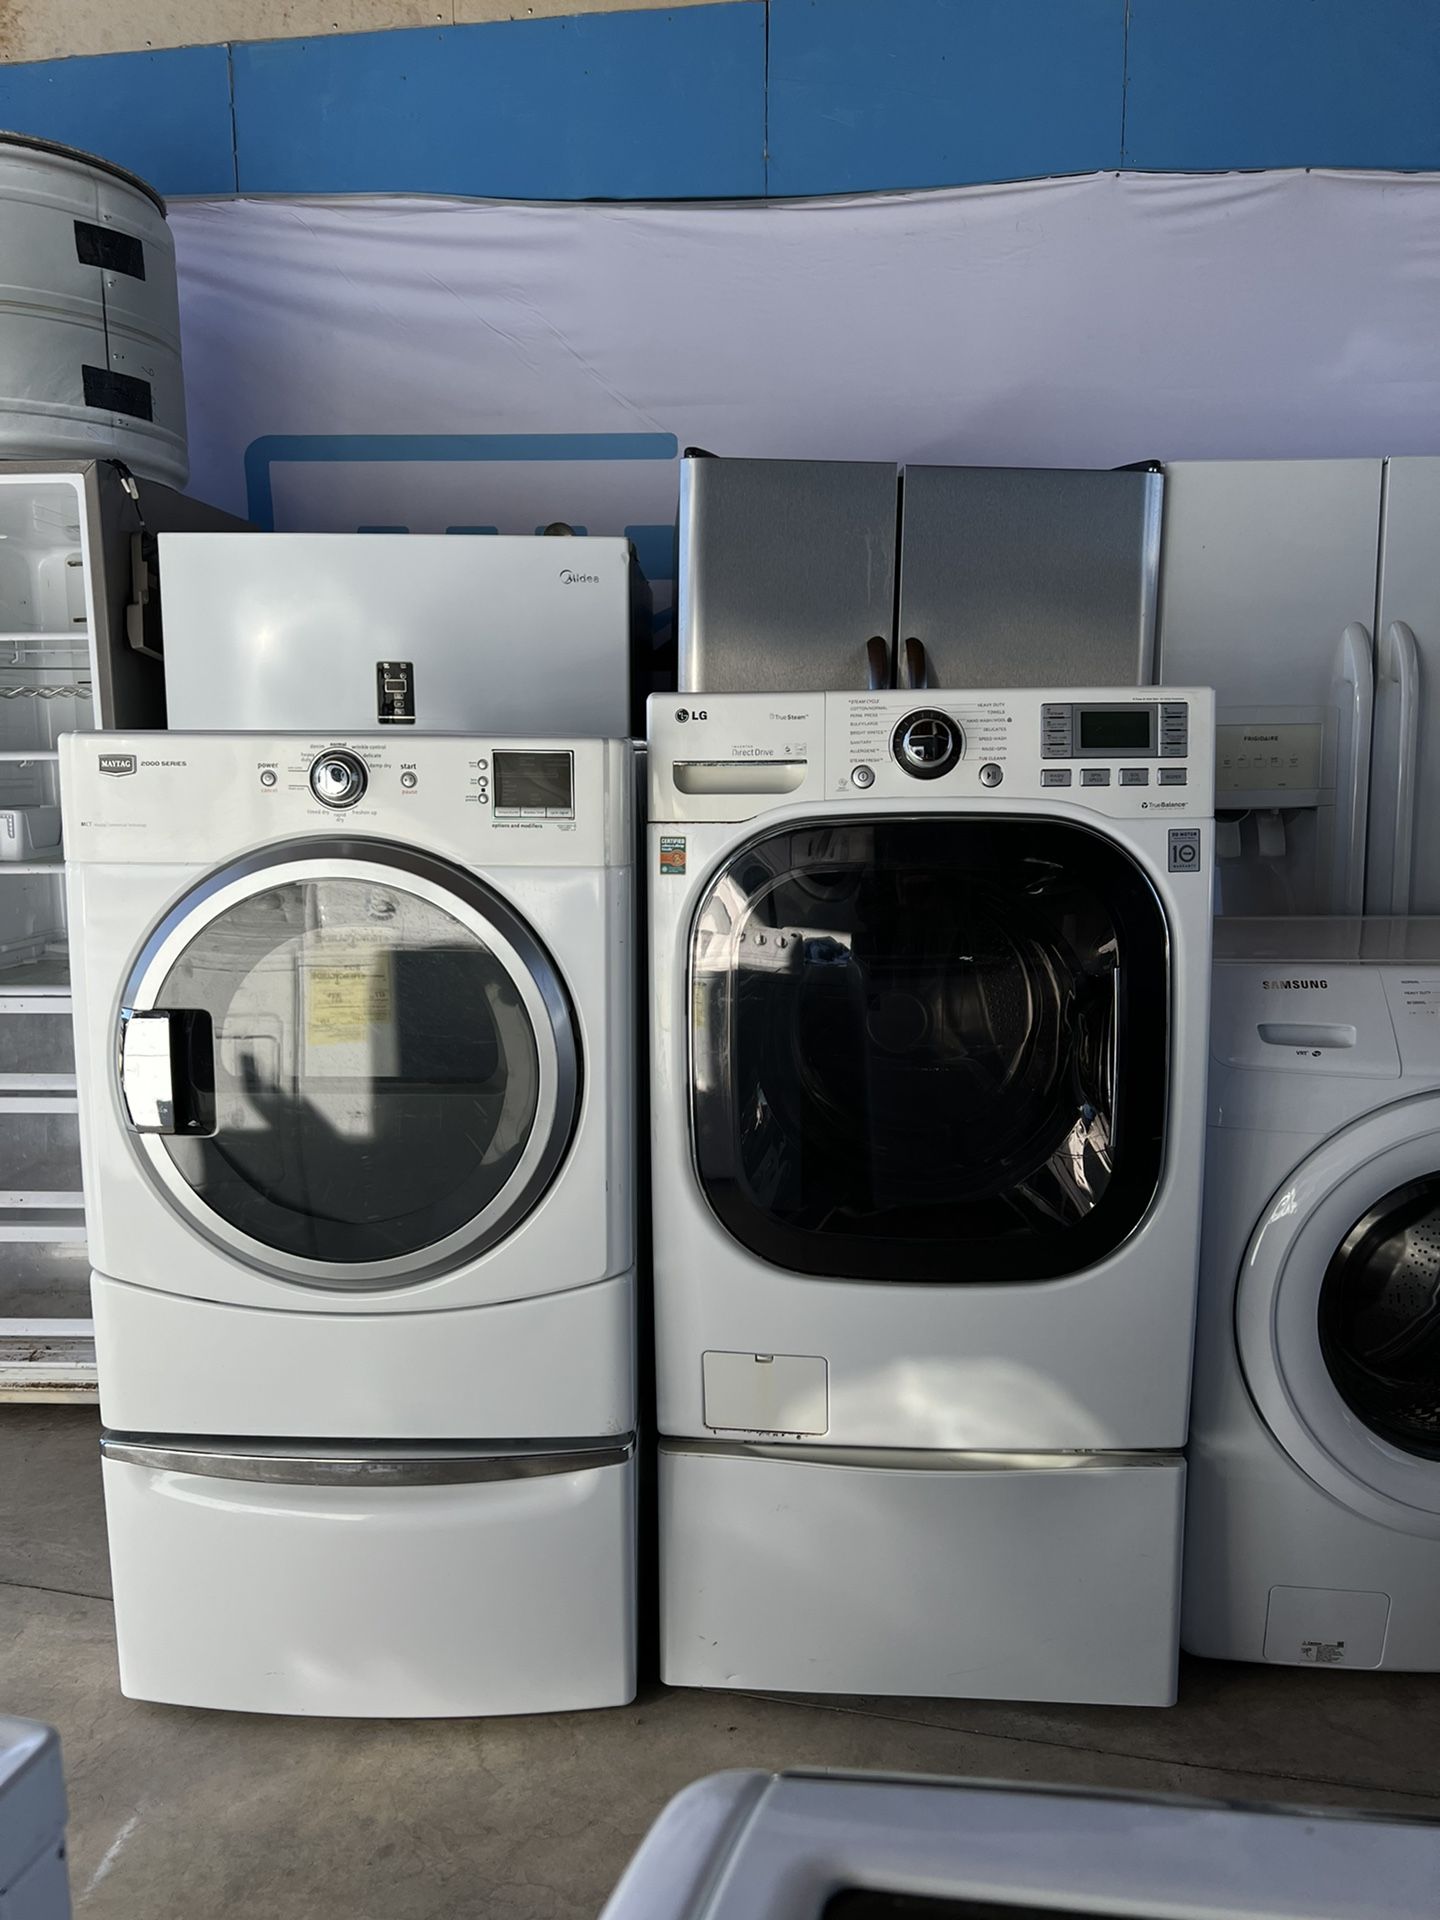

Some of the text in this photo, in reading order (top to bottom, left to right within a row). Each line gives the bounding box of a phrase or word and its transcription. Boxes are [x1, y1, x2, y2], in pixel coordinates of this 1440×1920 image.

[559, 569, 600, 585] Midea
[692, 711, 708, 720] LG
[101, 760, 131, 768] MAYTAG
[1262, 979, 1328, 990] SAMSUNG
